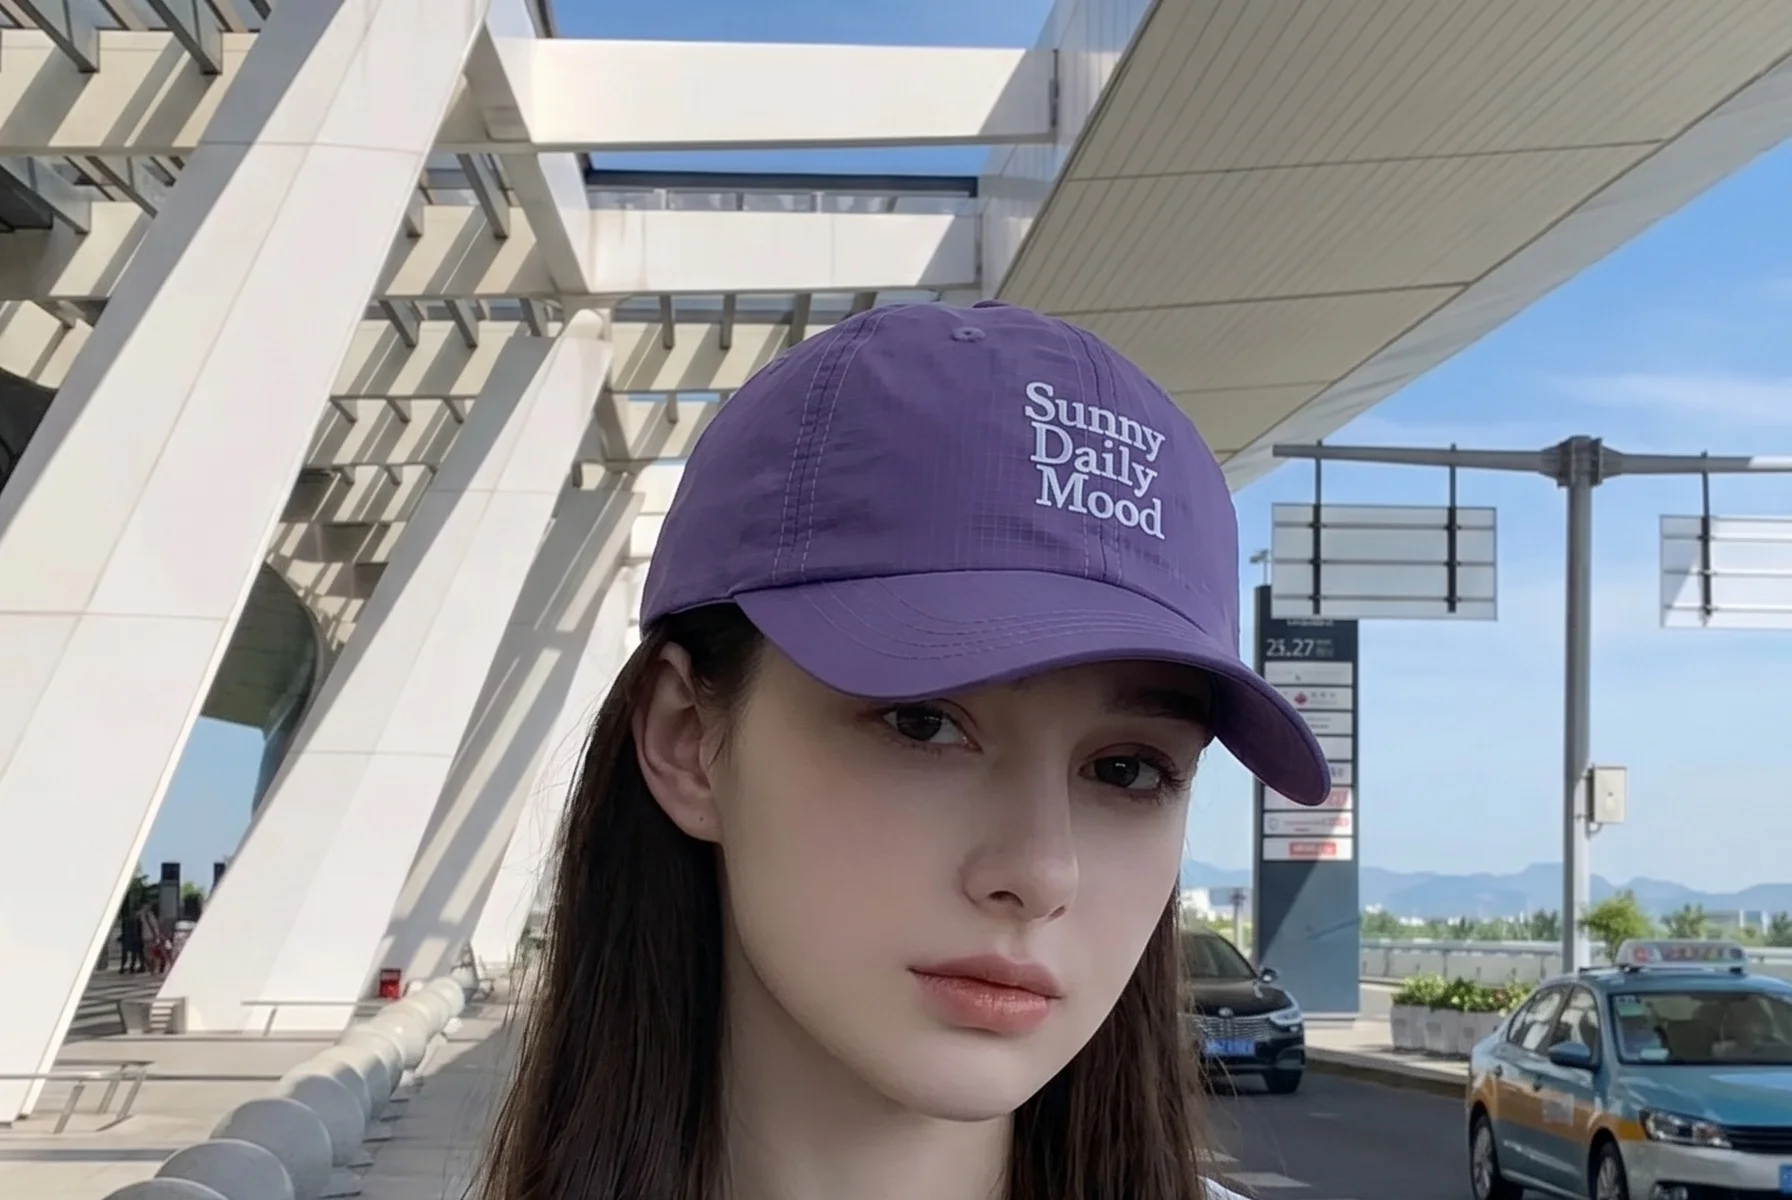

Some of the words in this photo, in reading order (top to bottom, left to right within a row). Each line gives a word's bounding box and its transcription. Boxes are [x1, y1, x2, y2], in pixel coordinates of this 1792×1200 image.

[1025, 382, 1166, 462] Sunny
[1030, 421, 1158, 498] Daily
[1035, 463, 1165, 540] Mood
